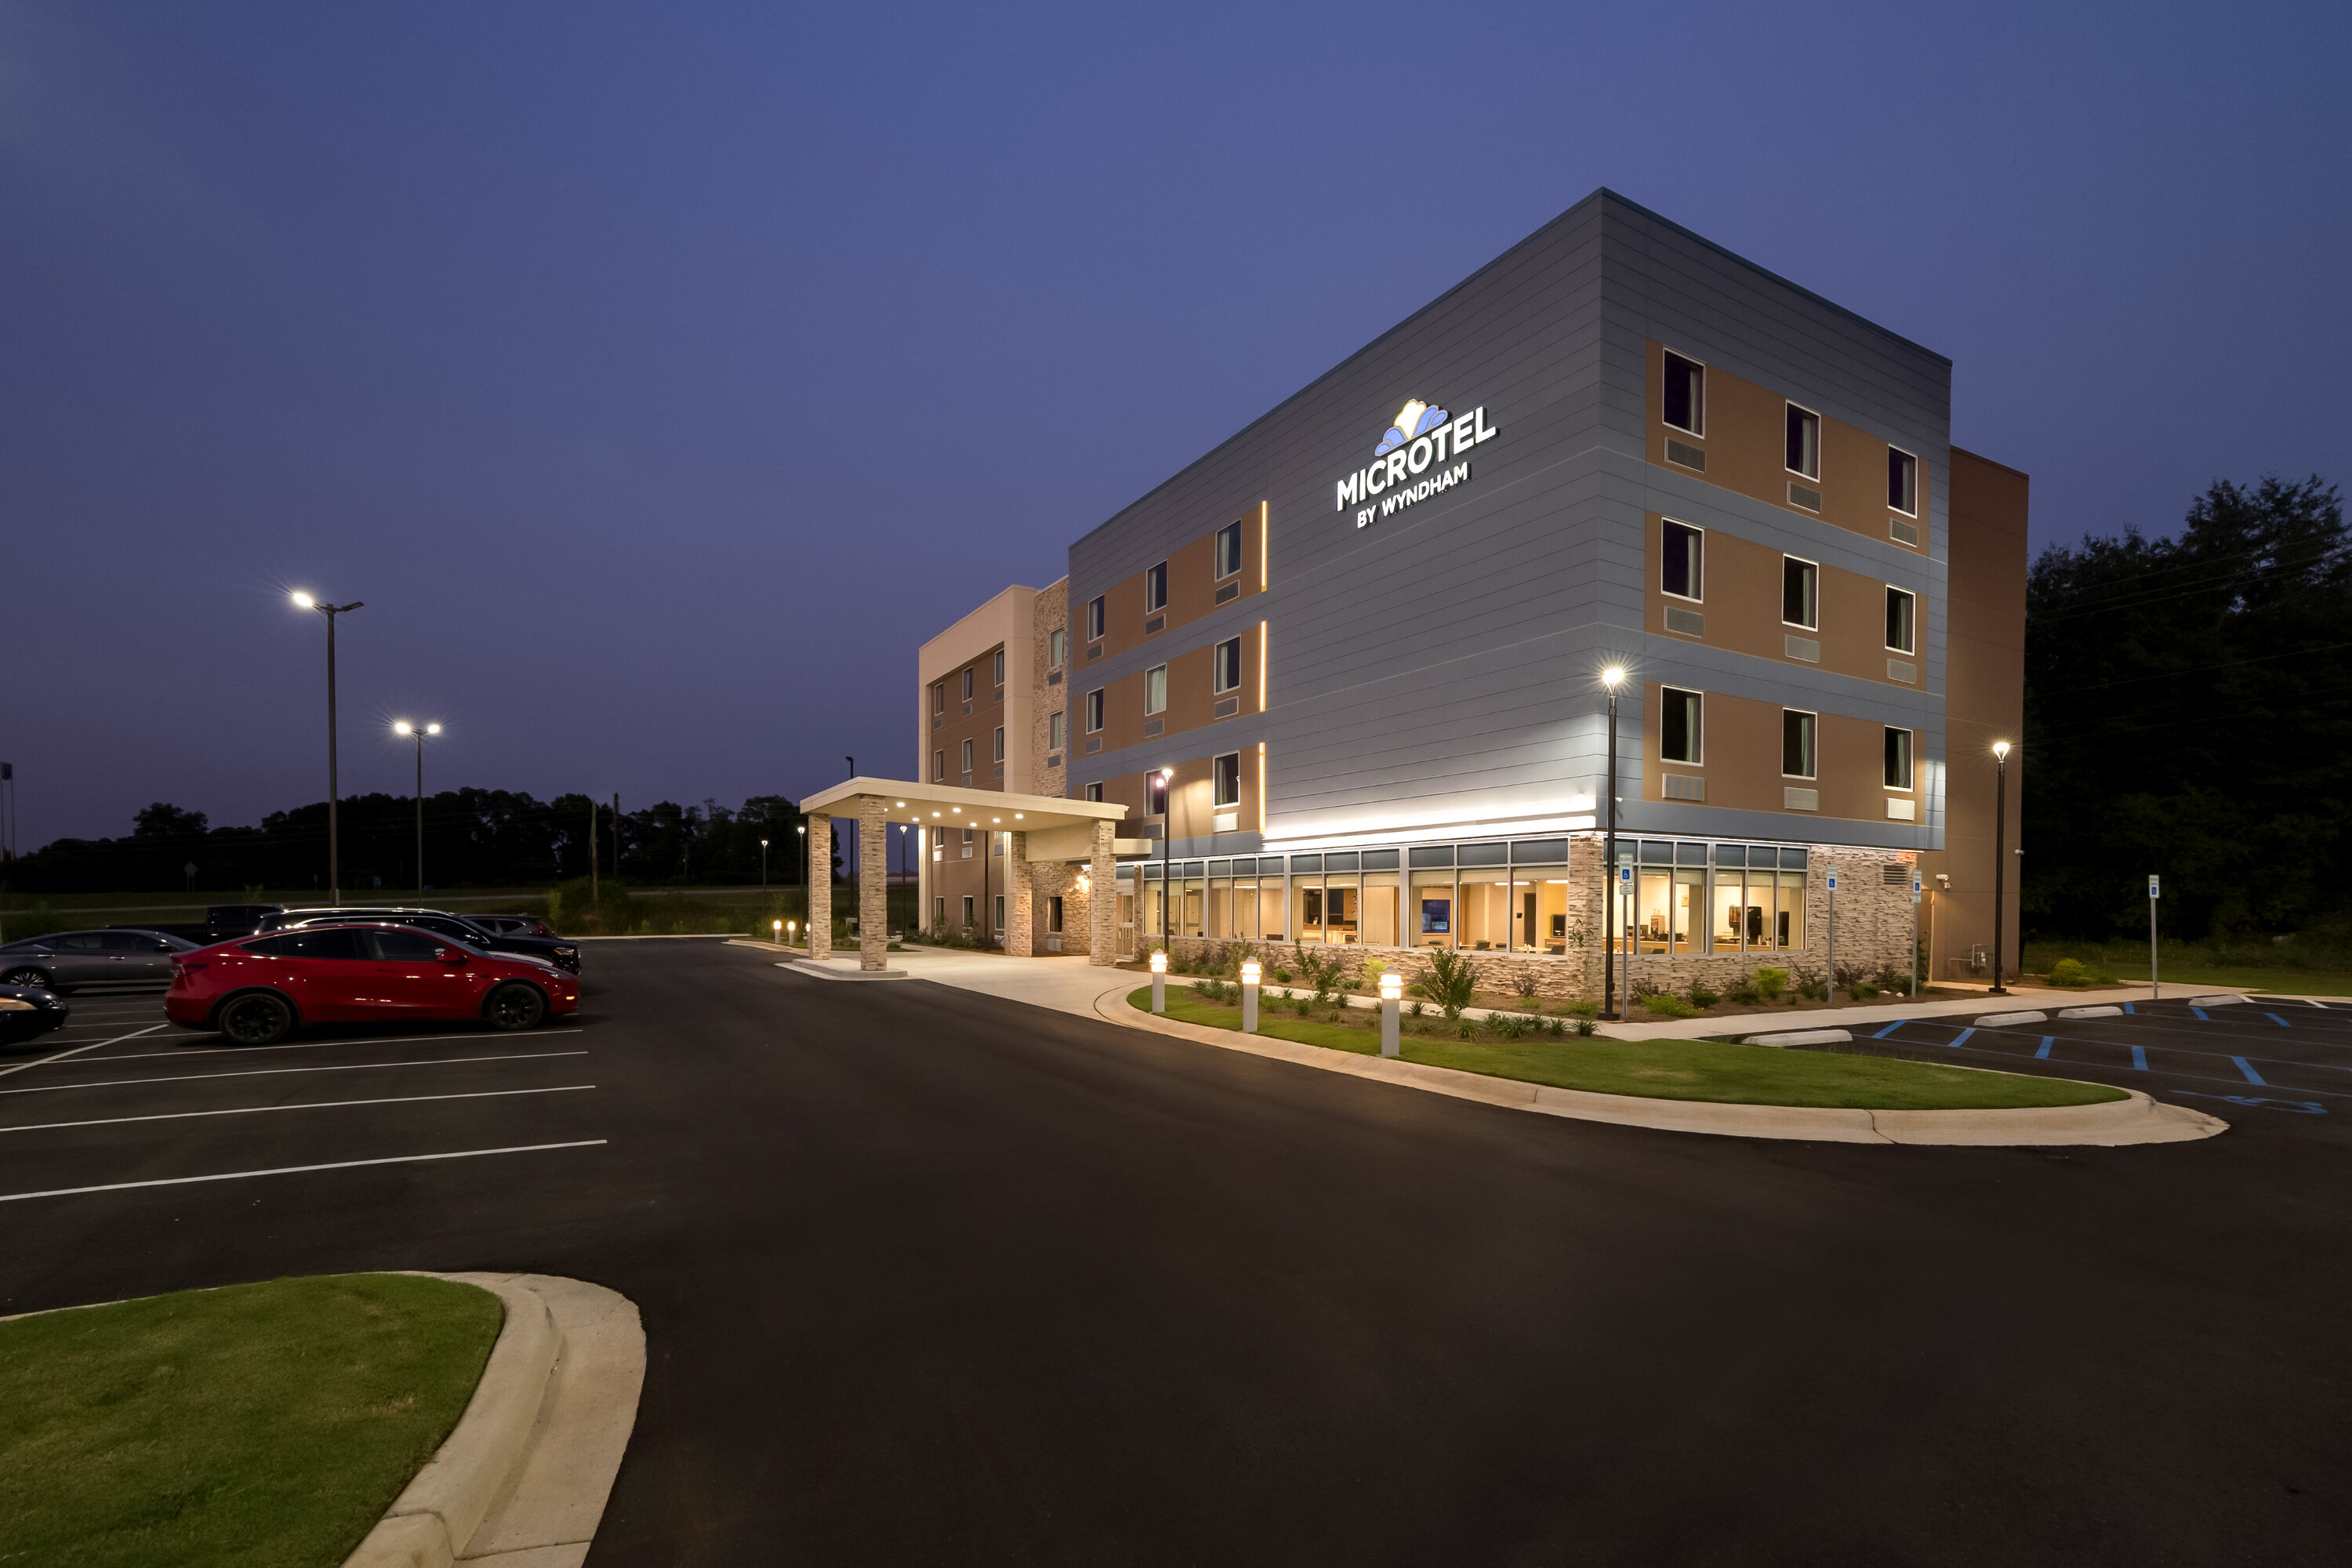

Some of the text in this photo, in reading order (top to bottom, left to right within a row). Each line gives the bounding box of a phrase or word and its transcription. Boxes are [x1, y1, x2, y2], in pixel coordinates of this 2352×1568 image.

[1337, 406, 1497, 512] MICROTEL
[1357, 462, 1468, 529] BY WYNDHAM
